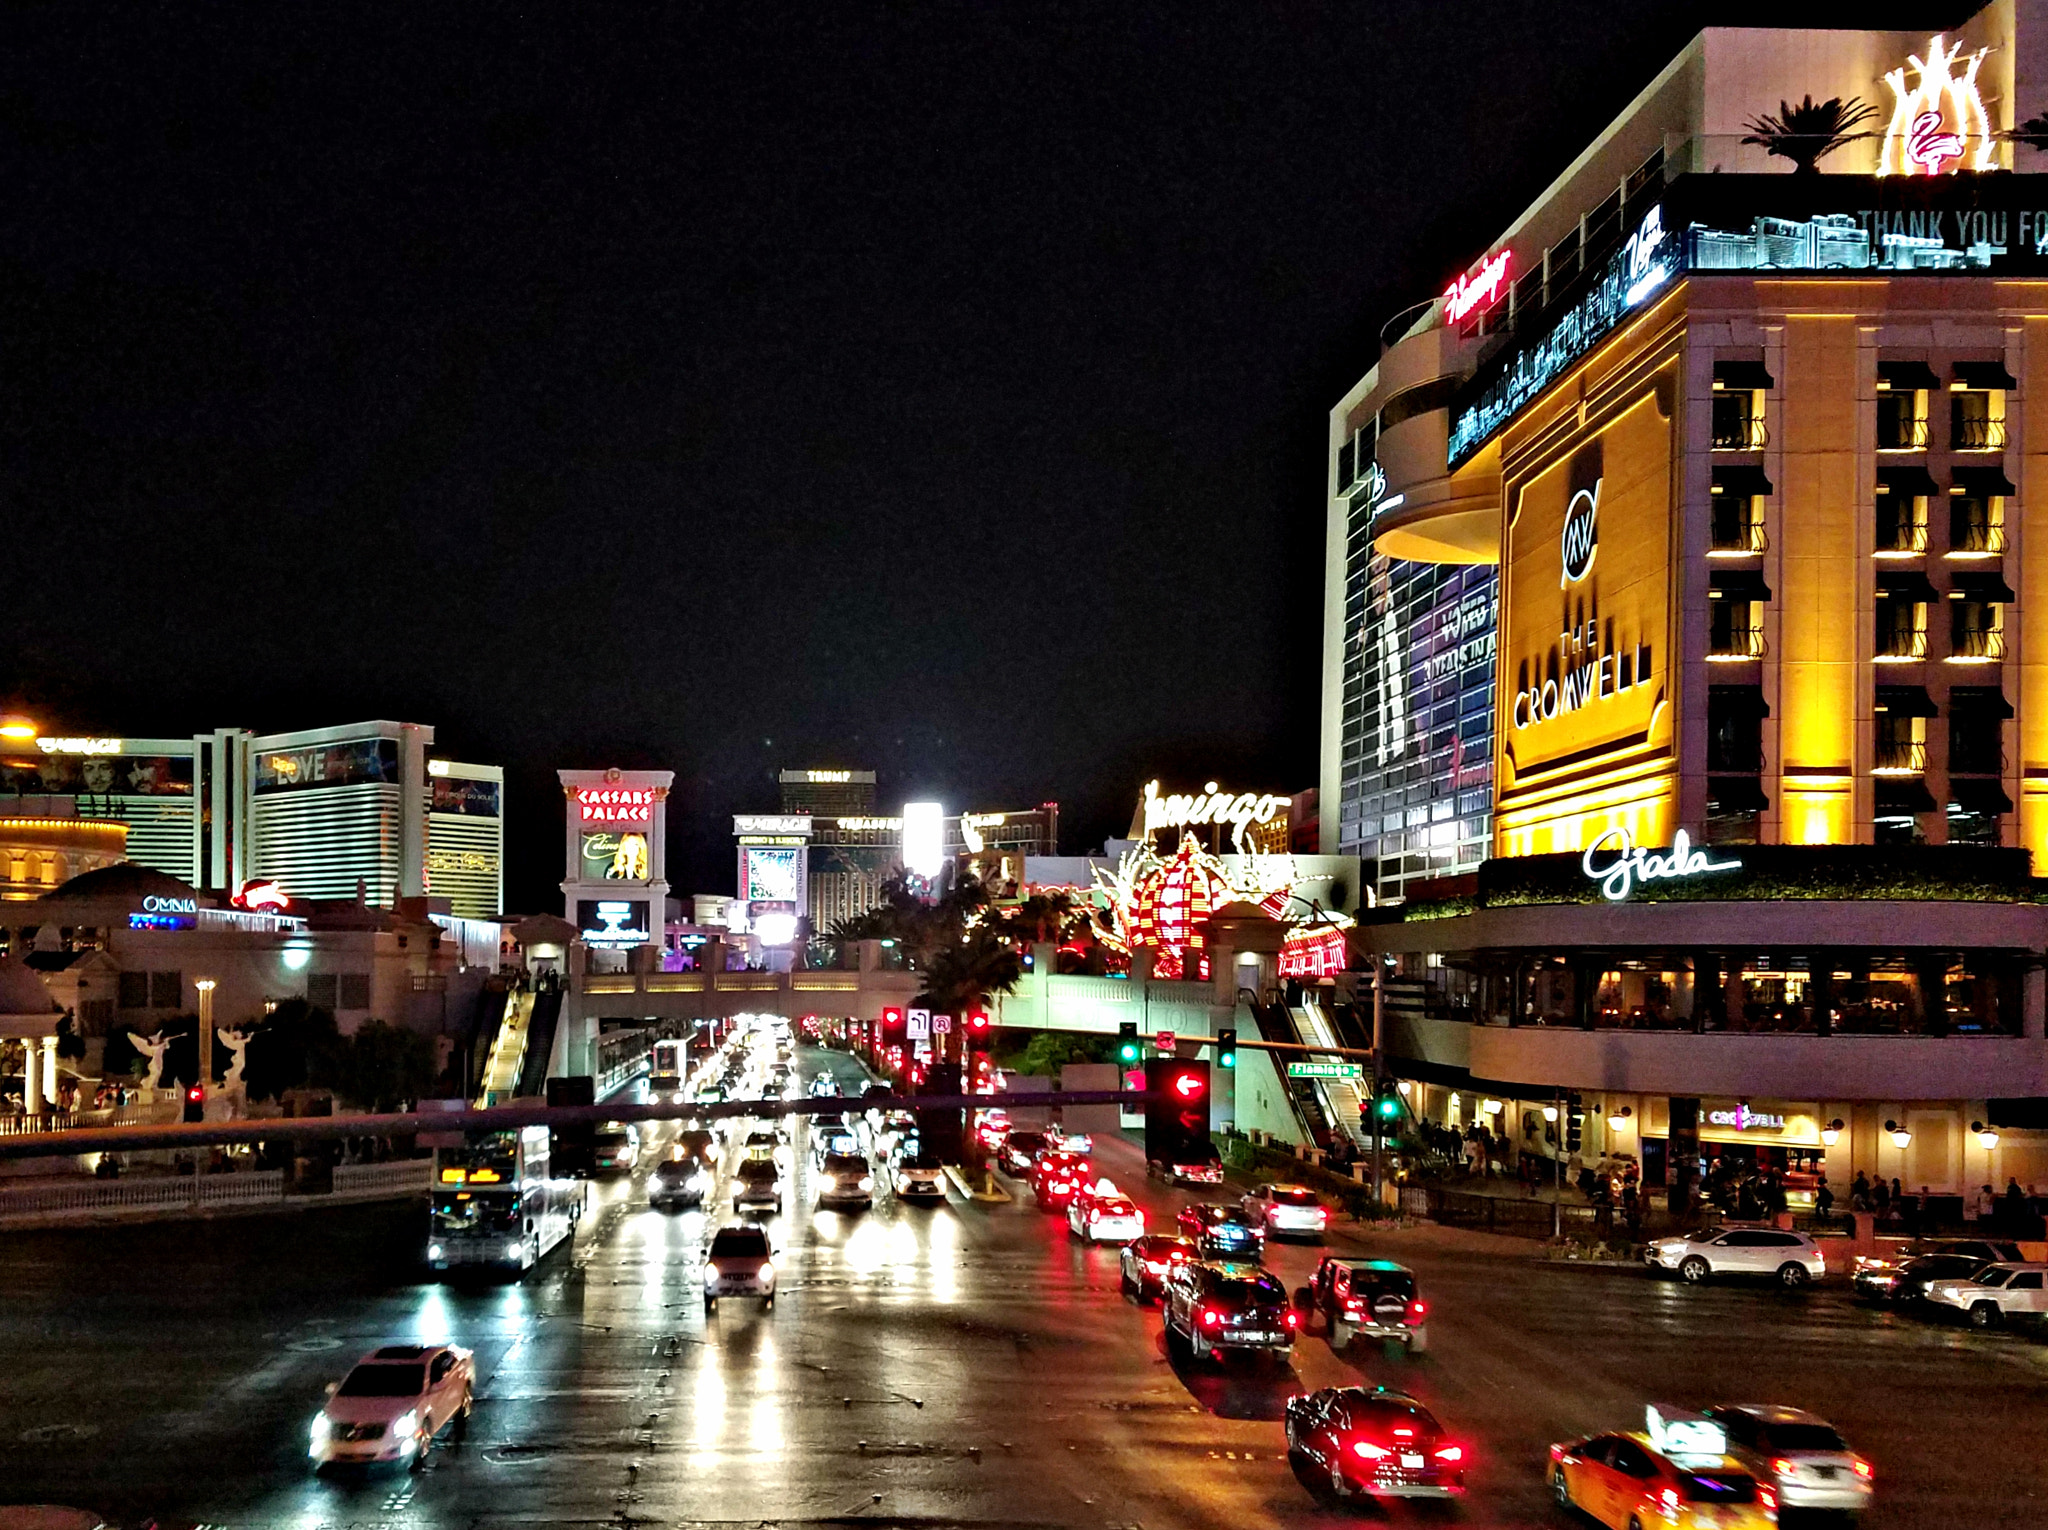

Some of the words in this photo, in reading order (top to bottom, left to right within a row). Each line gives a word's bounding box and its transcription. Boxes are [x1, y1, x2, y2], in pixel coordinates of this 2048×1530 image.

[1857, 210, 1944, 245] THANK
[1956, 210, 2008, 246] YOU
[1444, 249, 1511, 325] Flamingo
[1441, 594, 1487, 642] VOTED
[1560, 618, 1597, 659] THE
[1433, 645, 1469, 680] YEARS
[1471, 638, 1485, 661] IN
[1514, 642, 1652, 731] CROMWELL
[277, 752, 326, 786] LOVE
[807, 770, 851, 782] TRUMP
[578, 790, 653, 804] CAESARS
[582, 806, 649, 820] PALACE
[1583, 827, 1743, 900] Giada
[143, 896, 197, 913] OMNIA
[1295, 1063, 1350, 1077] Flamingo
[1709, 1111, 1786, 1128] CROWELL
